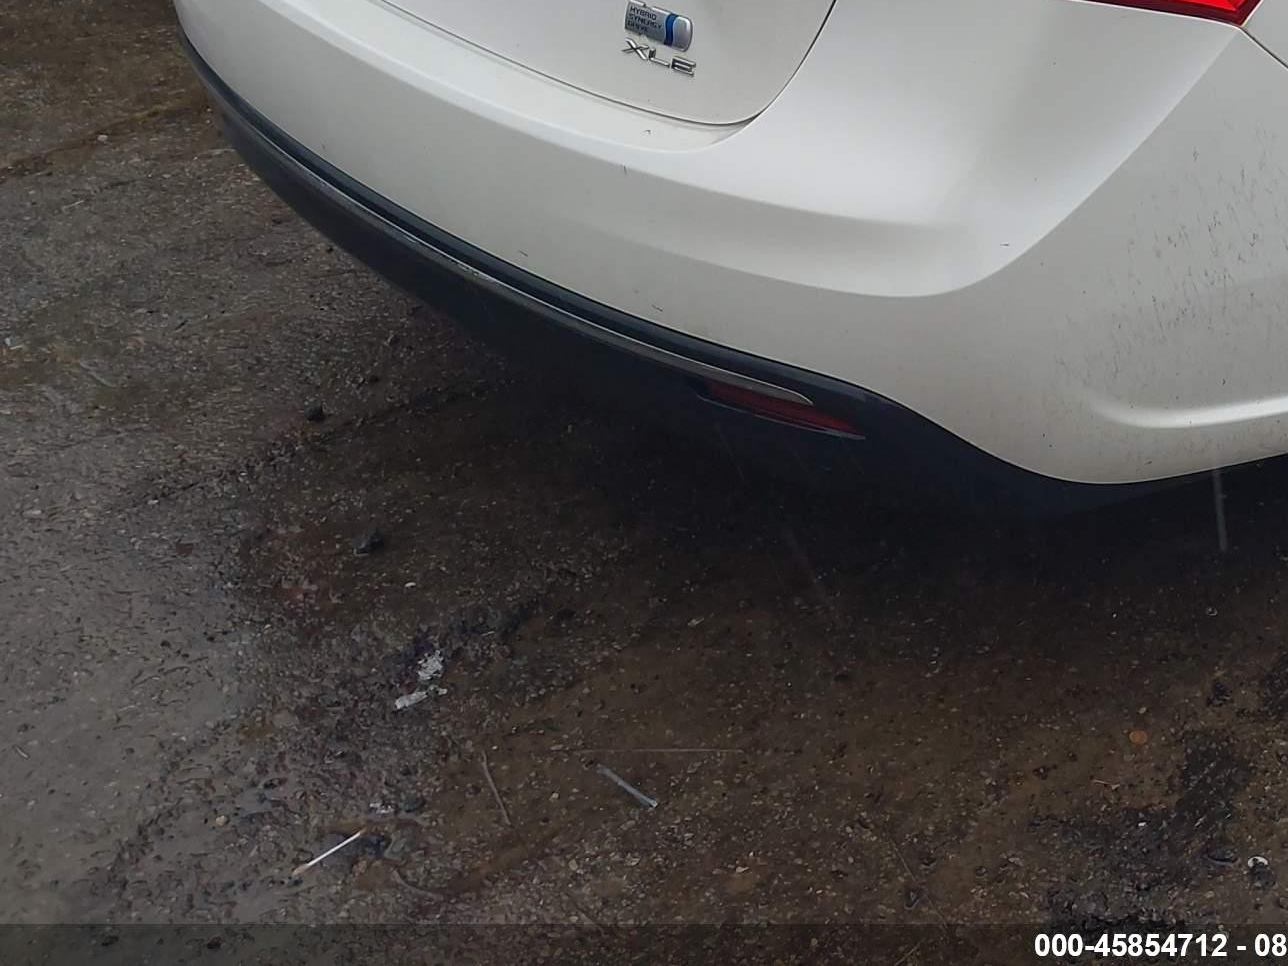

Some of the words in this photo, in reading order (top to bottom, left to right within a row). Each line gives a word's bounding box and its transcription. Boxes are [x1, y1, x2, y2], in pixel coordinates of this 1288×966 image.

[628, 13, 663, 30] SYNERGY
[629, 5, 657, 21] HYBRID
[621, 37, 697, 77] XLE
